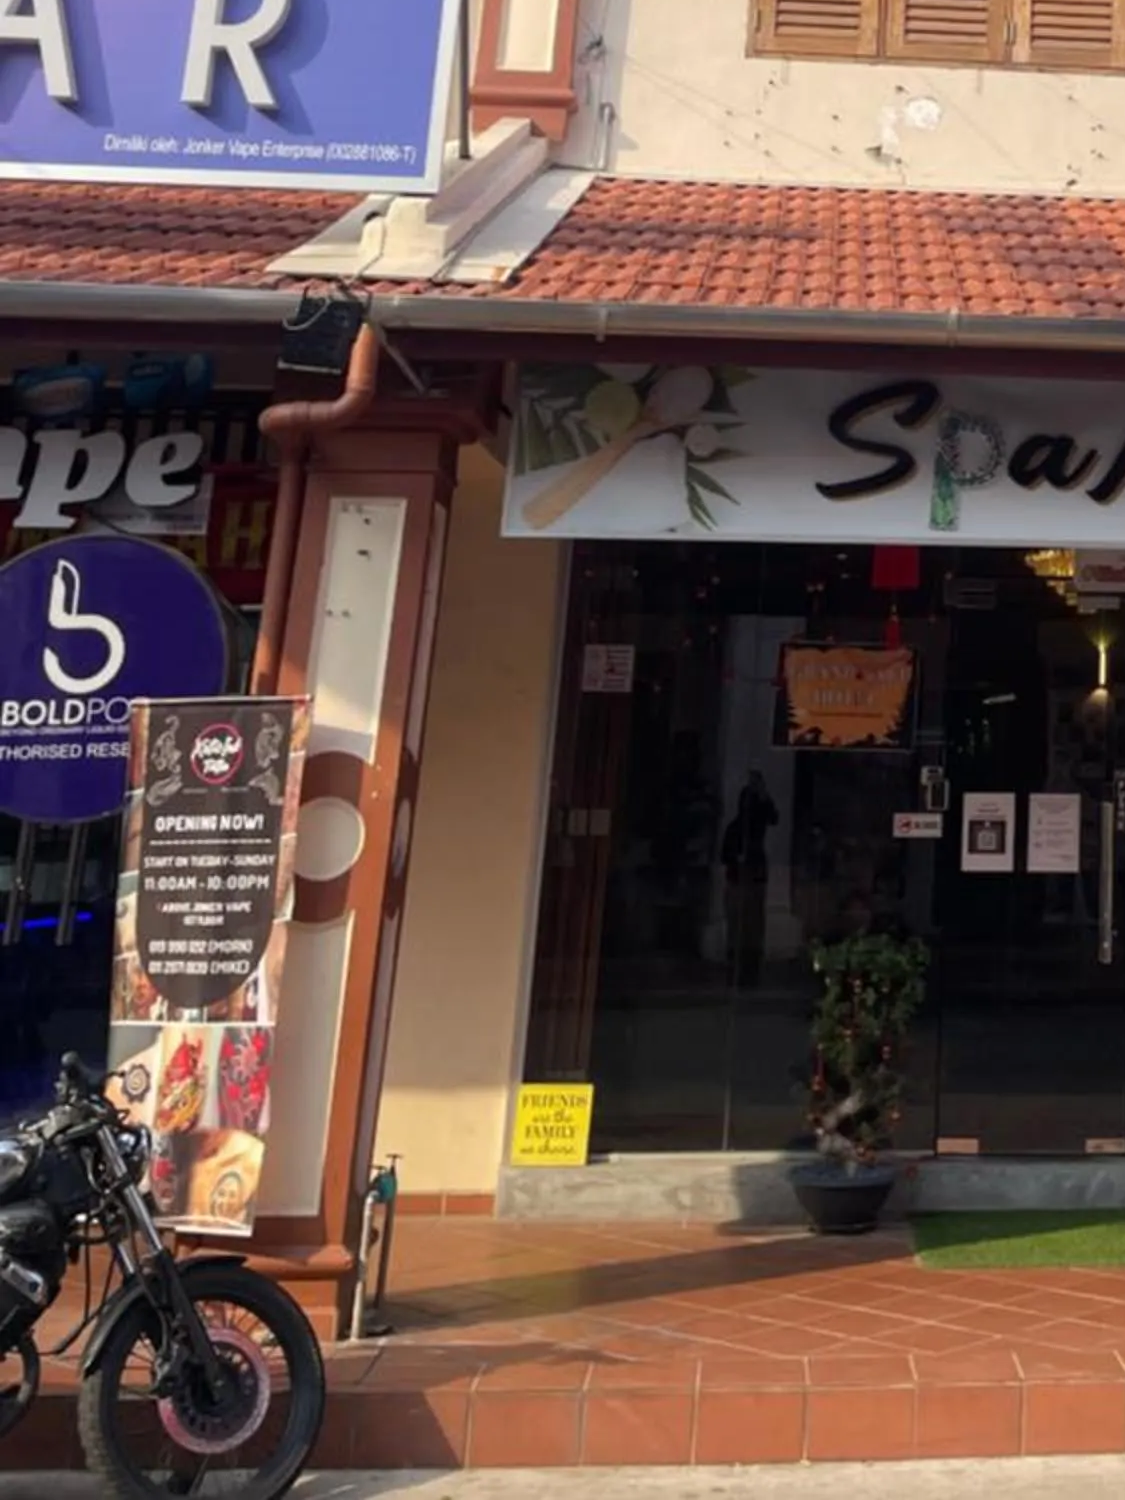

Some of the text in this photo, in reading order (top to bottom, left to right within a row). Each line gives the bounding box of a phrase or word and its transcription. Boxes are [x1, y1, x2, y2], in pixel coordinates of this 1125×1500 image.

[228, 139, 260, 159] Vape
[0, 425, 204, 530] pe
[154, 814, 218, 833] OPENING
[521, 1093, 588, 1109] FRIENDS
[524, 1124, 578, 1139] FAMILY
